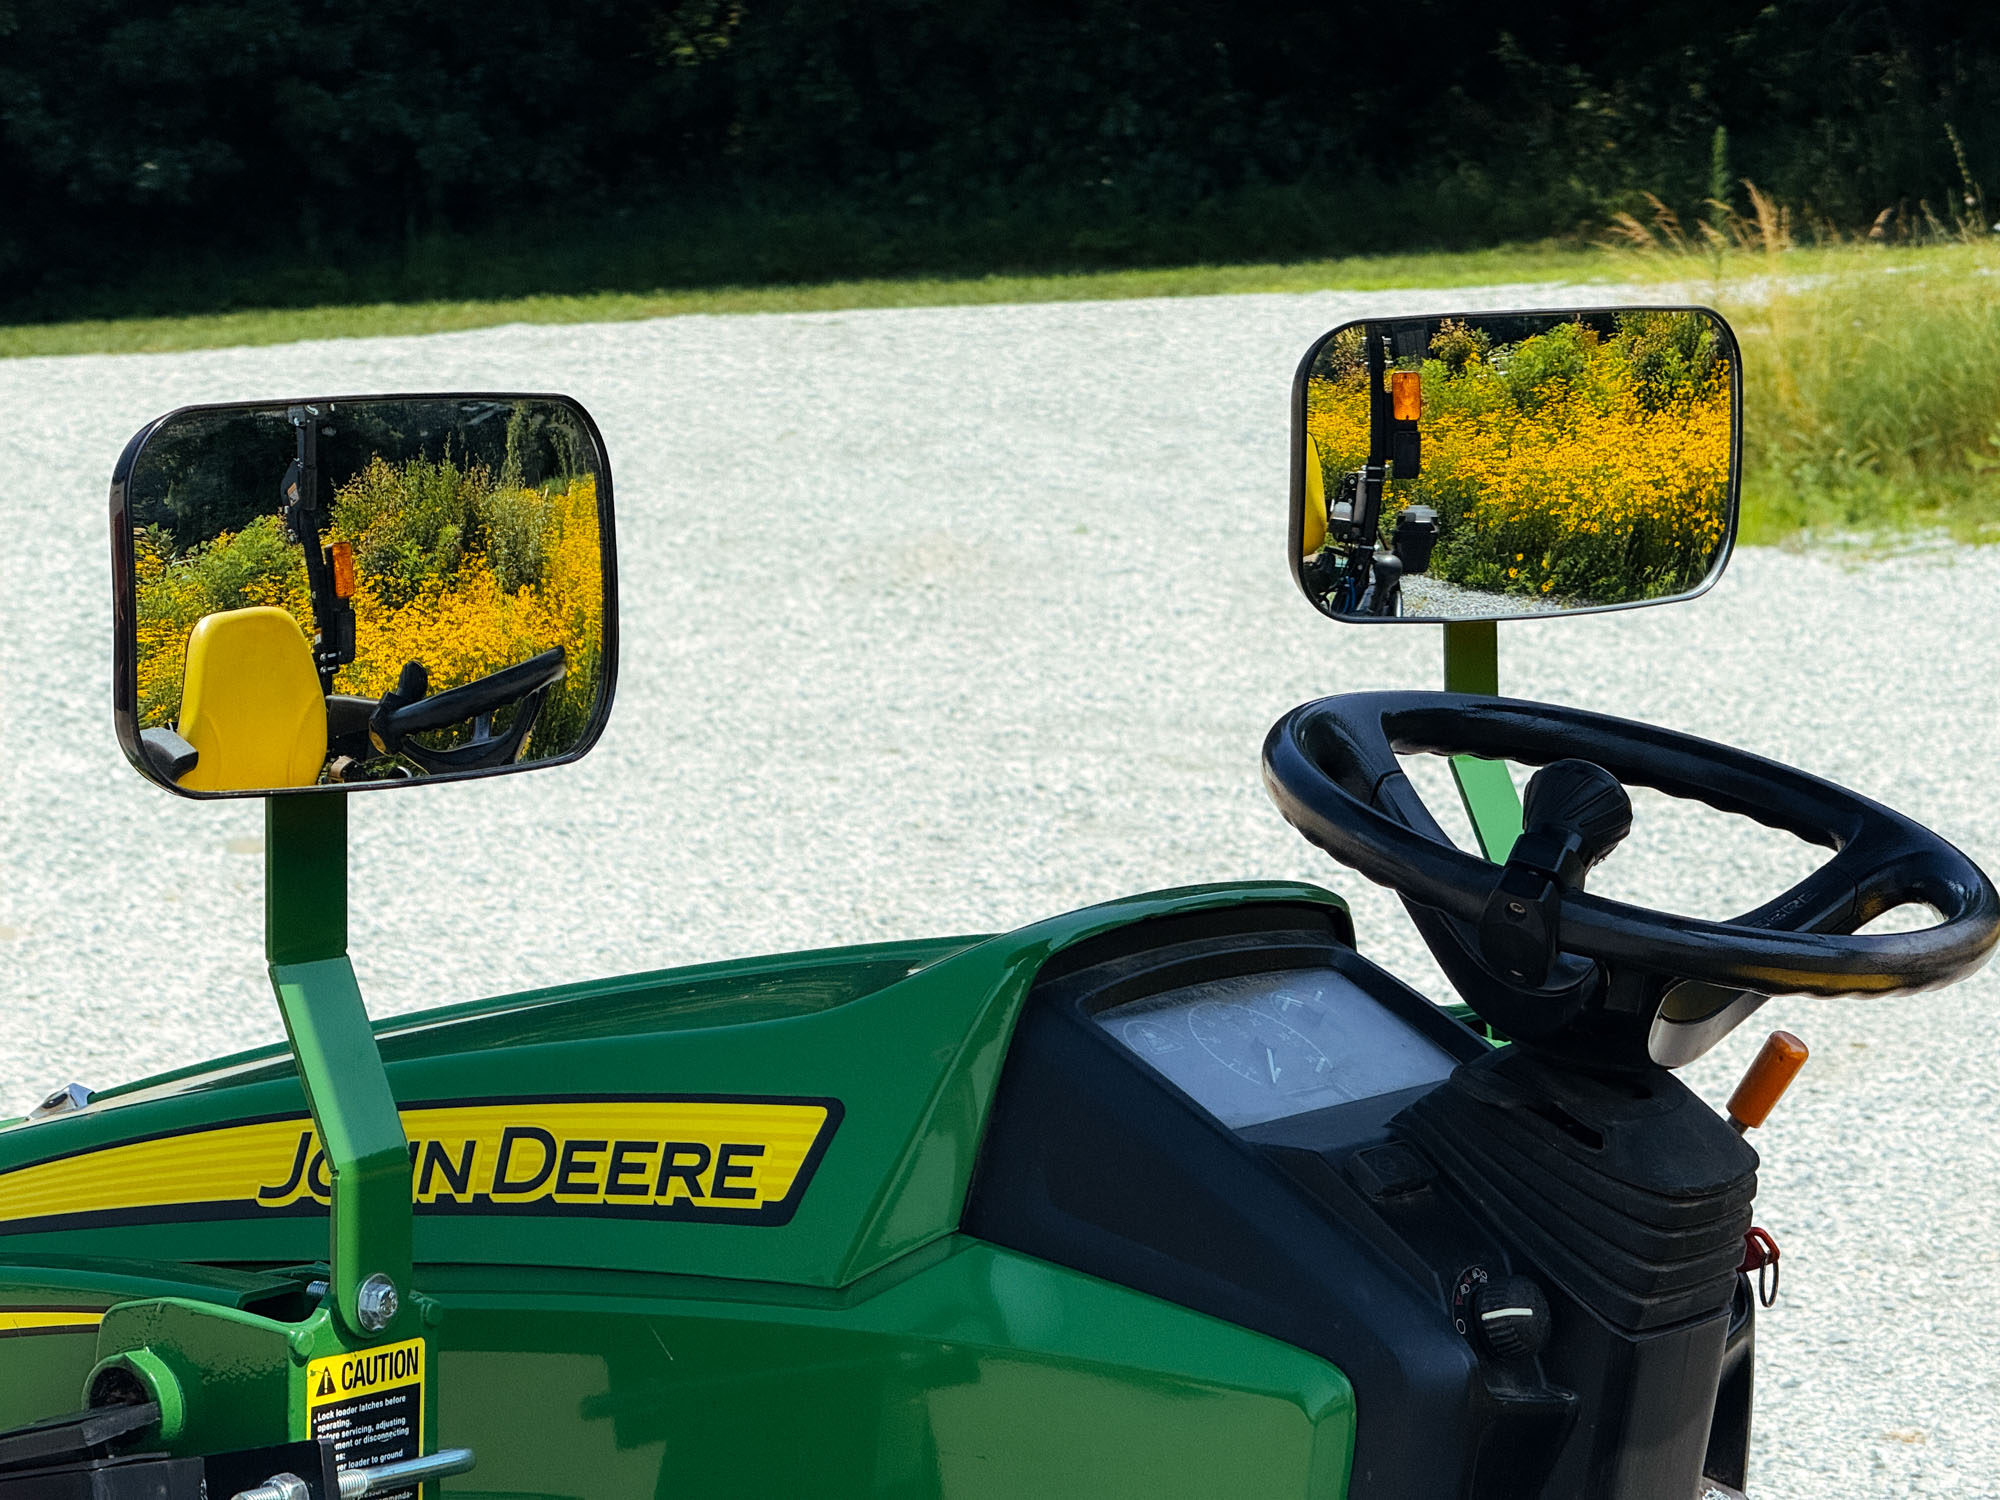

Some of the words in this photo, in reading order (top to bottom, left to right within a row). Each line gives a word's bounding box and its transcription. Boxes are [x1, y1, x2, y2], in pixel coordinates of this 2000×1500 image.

[491, 1126, 766, 1201] DEERE
[341, 1346, 419, 1391] CAUTION
[317, 1410, 335, 1422] Lock
[335, 1406, 358, 1418] loader
[359, 1400, 384, 1412] latches
[384, 1395, 406, 1407] before
[317, 1419, 352, 1433] operating.
[341, 1425, 375, 1438] servicing,
[375, 1417, 406, 1430] adjusting
[354, 1438, 362, 1446] or
[363, 1427, 410, 1444] disconnecting
[348, 1457, 370, 1469] loader
[371, 1455, 379, 1464] to
[379, 1448, 404, 1463] ground
